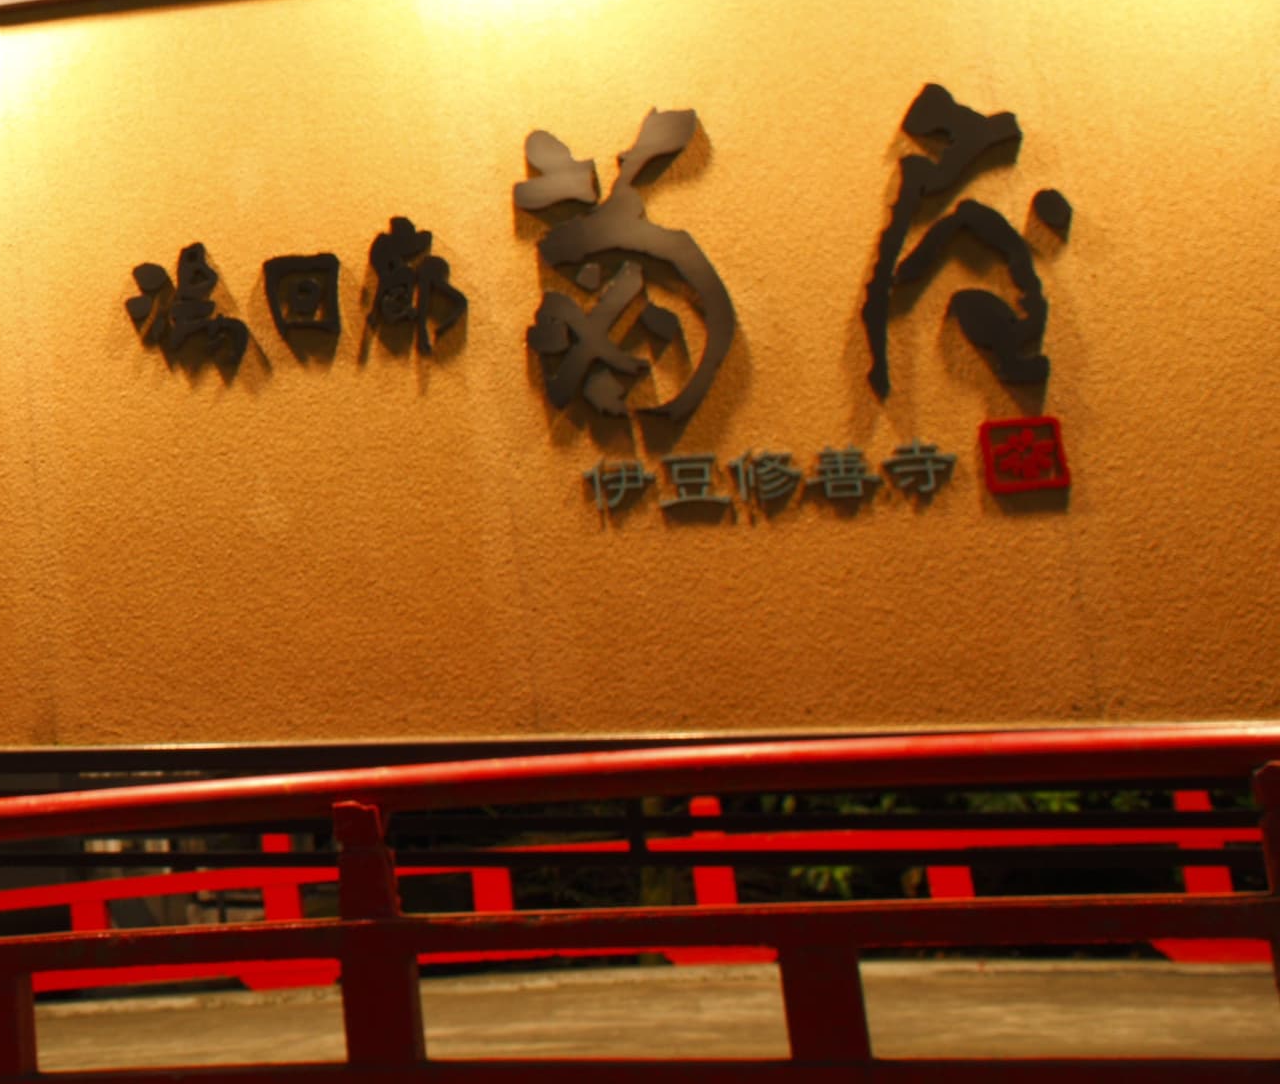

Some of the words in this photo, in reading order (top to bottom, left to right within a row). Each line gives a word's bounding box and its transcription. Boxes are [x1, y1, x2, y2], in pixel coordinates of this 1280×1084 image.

[583, 438, 957, 511] 伊豆修善寺
